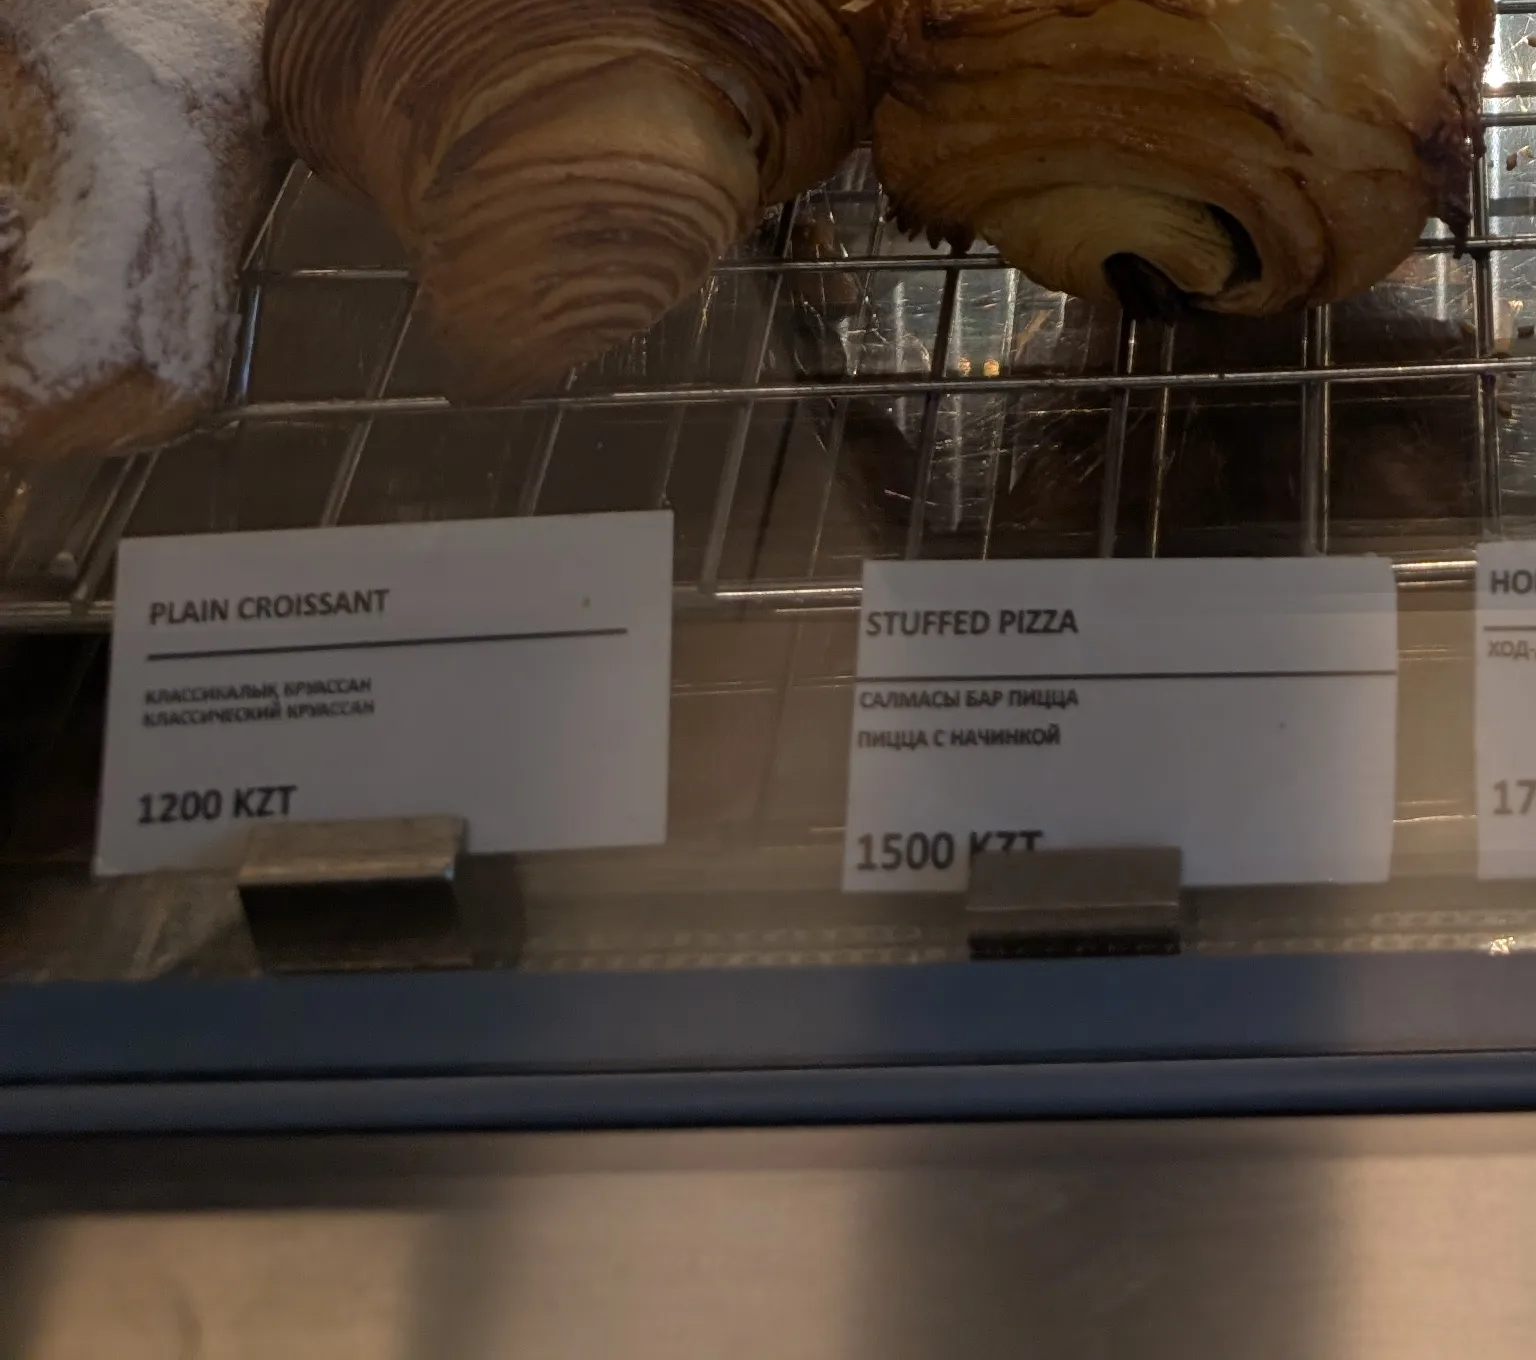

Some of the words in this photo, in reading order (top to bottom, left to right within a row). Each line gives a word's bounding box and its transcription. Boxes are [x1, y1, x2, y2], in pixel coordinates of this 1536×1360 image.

[150, 598, 228, 625] PLAIN
[237, 589, 389, 620] CROISSANT
[866, 610, 990, 637] STUFFED
[1000, 609, 1078, 634] PIZZA
[860, 690, 960, 709] САЛМАСЫ
[966, 689, 1003, 708] БАР
[1008, 688, 1079, 710] ПИЦЦА
[858, 728, 928, 750] ПИЦЦА
[934, 728, 945, 747] С
[950, 724, 1060, 747] НАЧИНКОЙ
[137, 789, 222, 825] 1200
[233, 785, 297, 819] KZT
[856, 832, 955, 871] 1500
